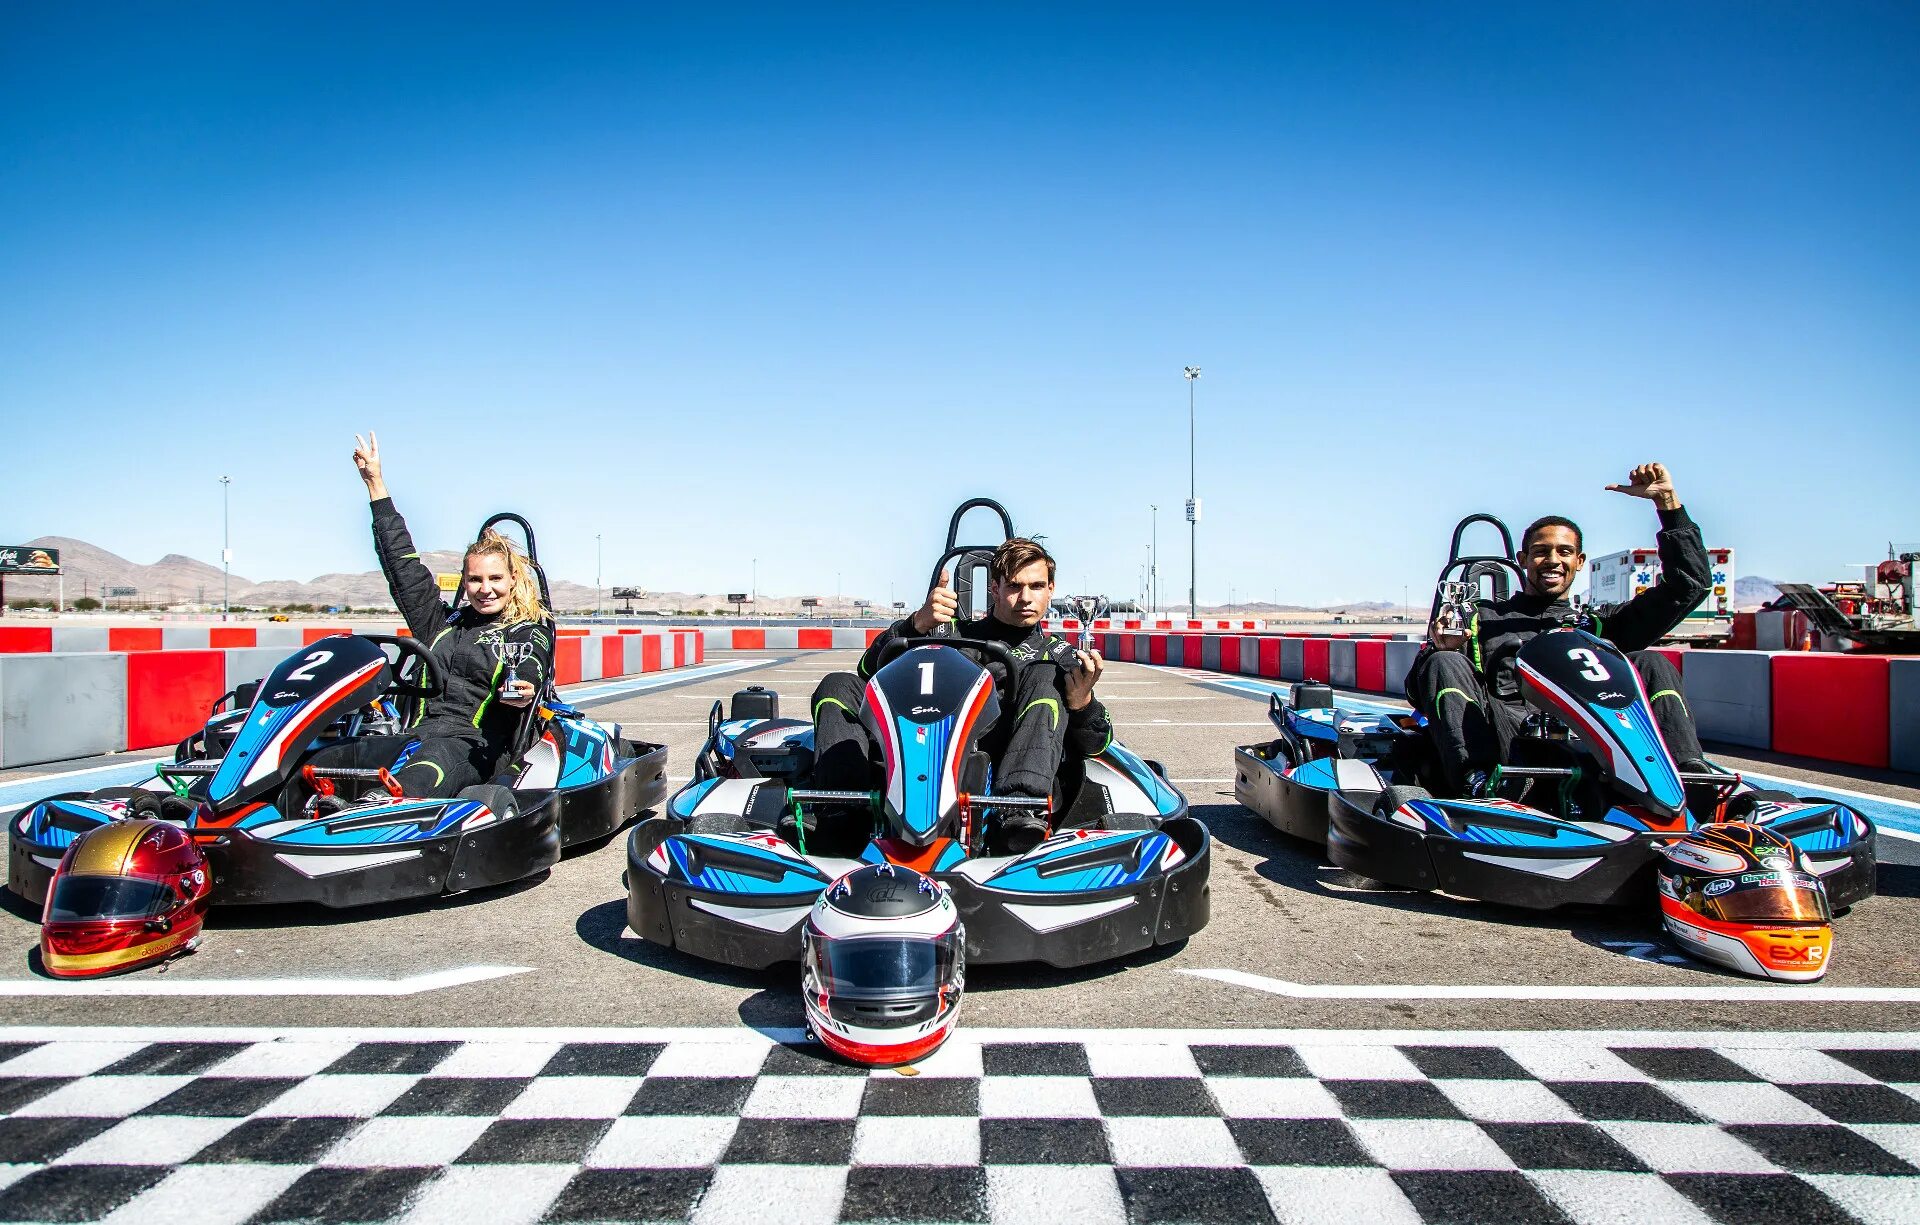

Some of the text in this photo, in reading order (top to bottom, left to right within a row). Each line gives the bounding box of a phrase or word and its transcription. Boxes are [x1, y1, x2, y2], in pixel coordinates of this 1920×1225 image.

[286, 650, 334, 681] 2
[918, 662, 935, 695] 1
[1567, 648, 1611, 682] 3
[1754, 846, 1790, 857] EXR
[1769, 945, 1823, 961] EXR
